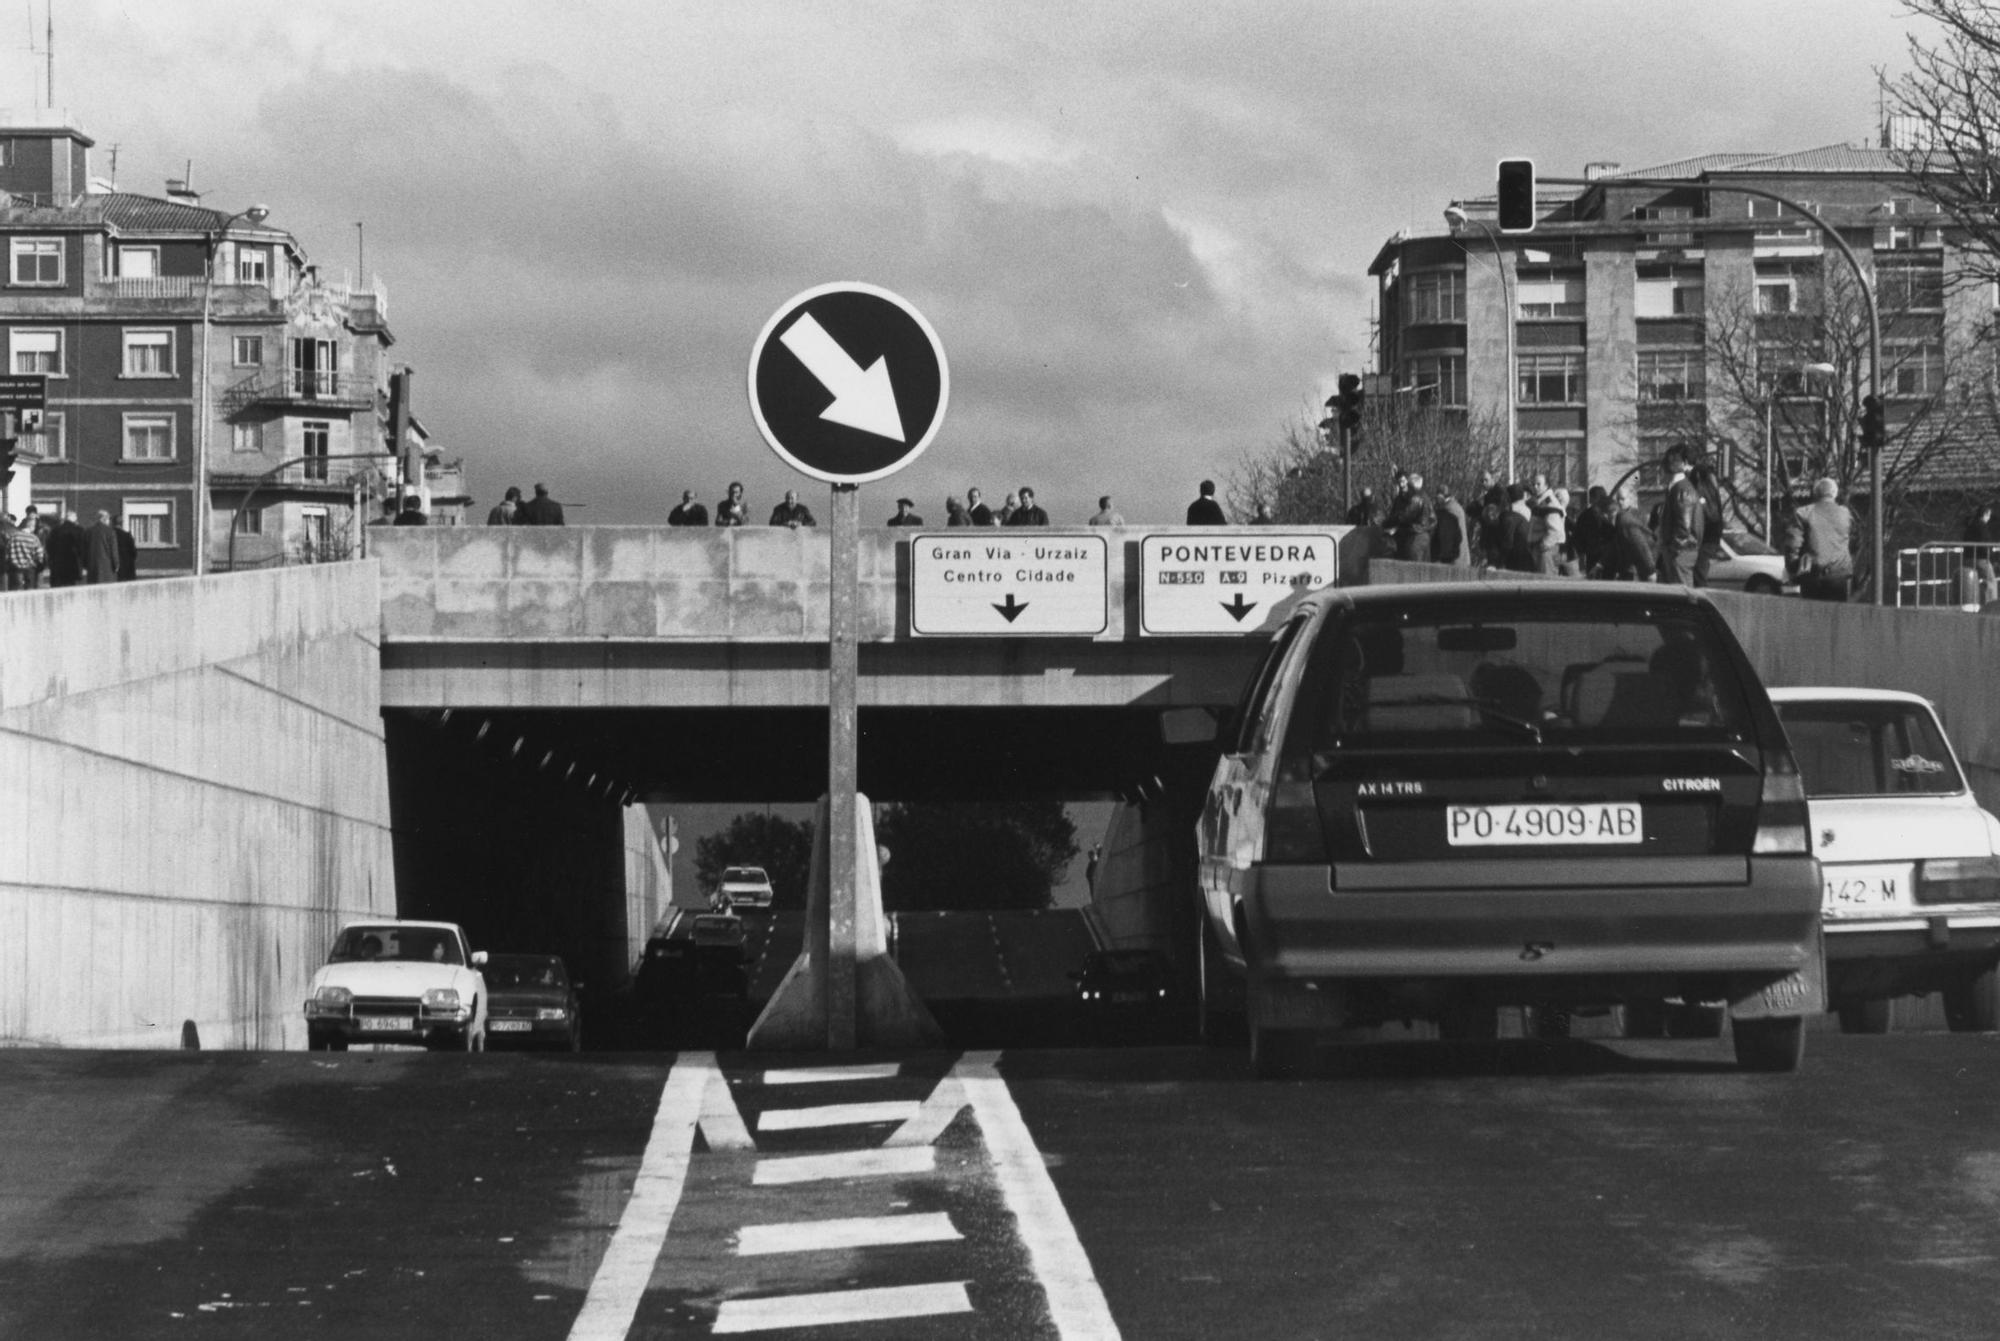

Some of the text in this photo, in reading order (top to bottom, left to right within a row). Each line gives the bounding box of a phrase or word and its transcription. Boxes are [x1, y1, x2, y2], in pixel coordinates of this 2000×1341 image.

[932, 547, 971, 560] Gran
[1034, 547, 1089, 560] Urzaiz
[1161, 545, 1316, 562] PONTEVEDRA
[943, 569, 1076, 583] Centro Cidade
[1357, 782, 1377, 796] AX
